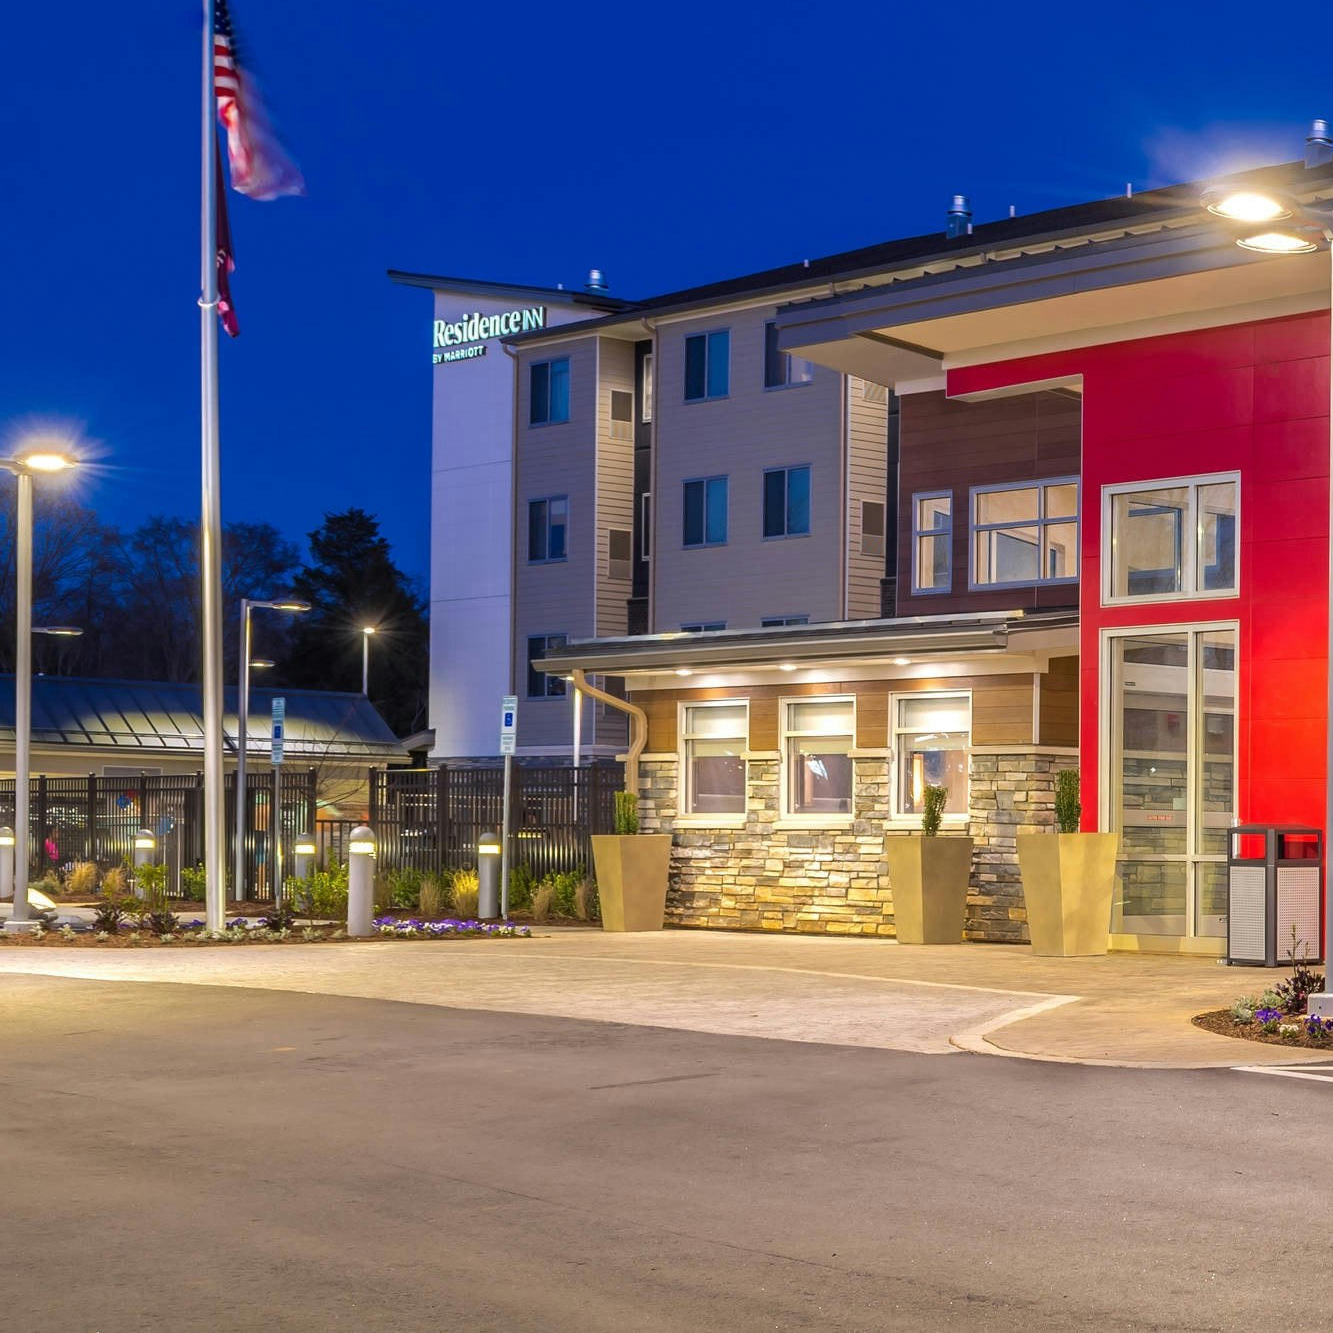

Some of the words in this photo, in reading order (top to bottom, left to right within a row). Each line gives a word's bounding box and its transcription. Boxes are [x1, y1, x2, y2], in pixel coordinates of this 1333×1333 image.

[433, 310, 521, 348] Residence
[432, 353, 443, 364] BY
[444, 345, 484, 362] MARRIOTT
